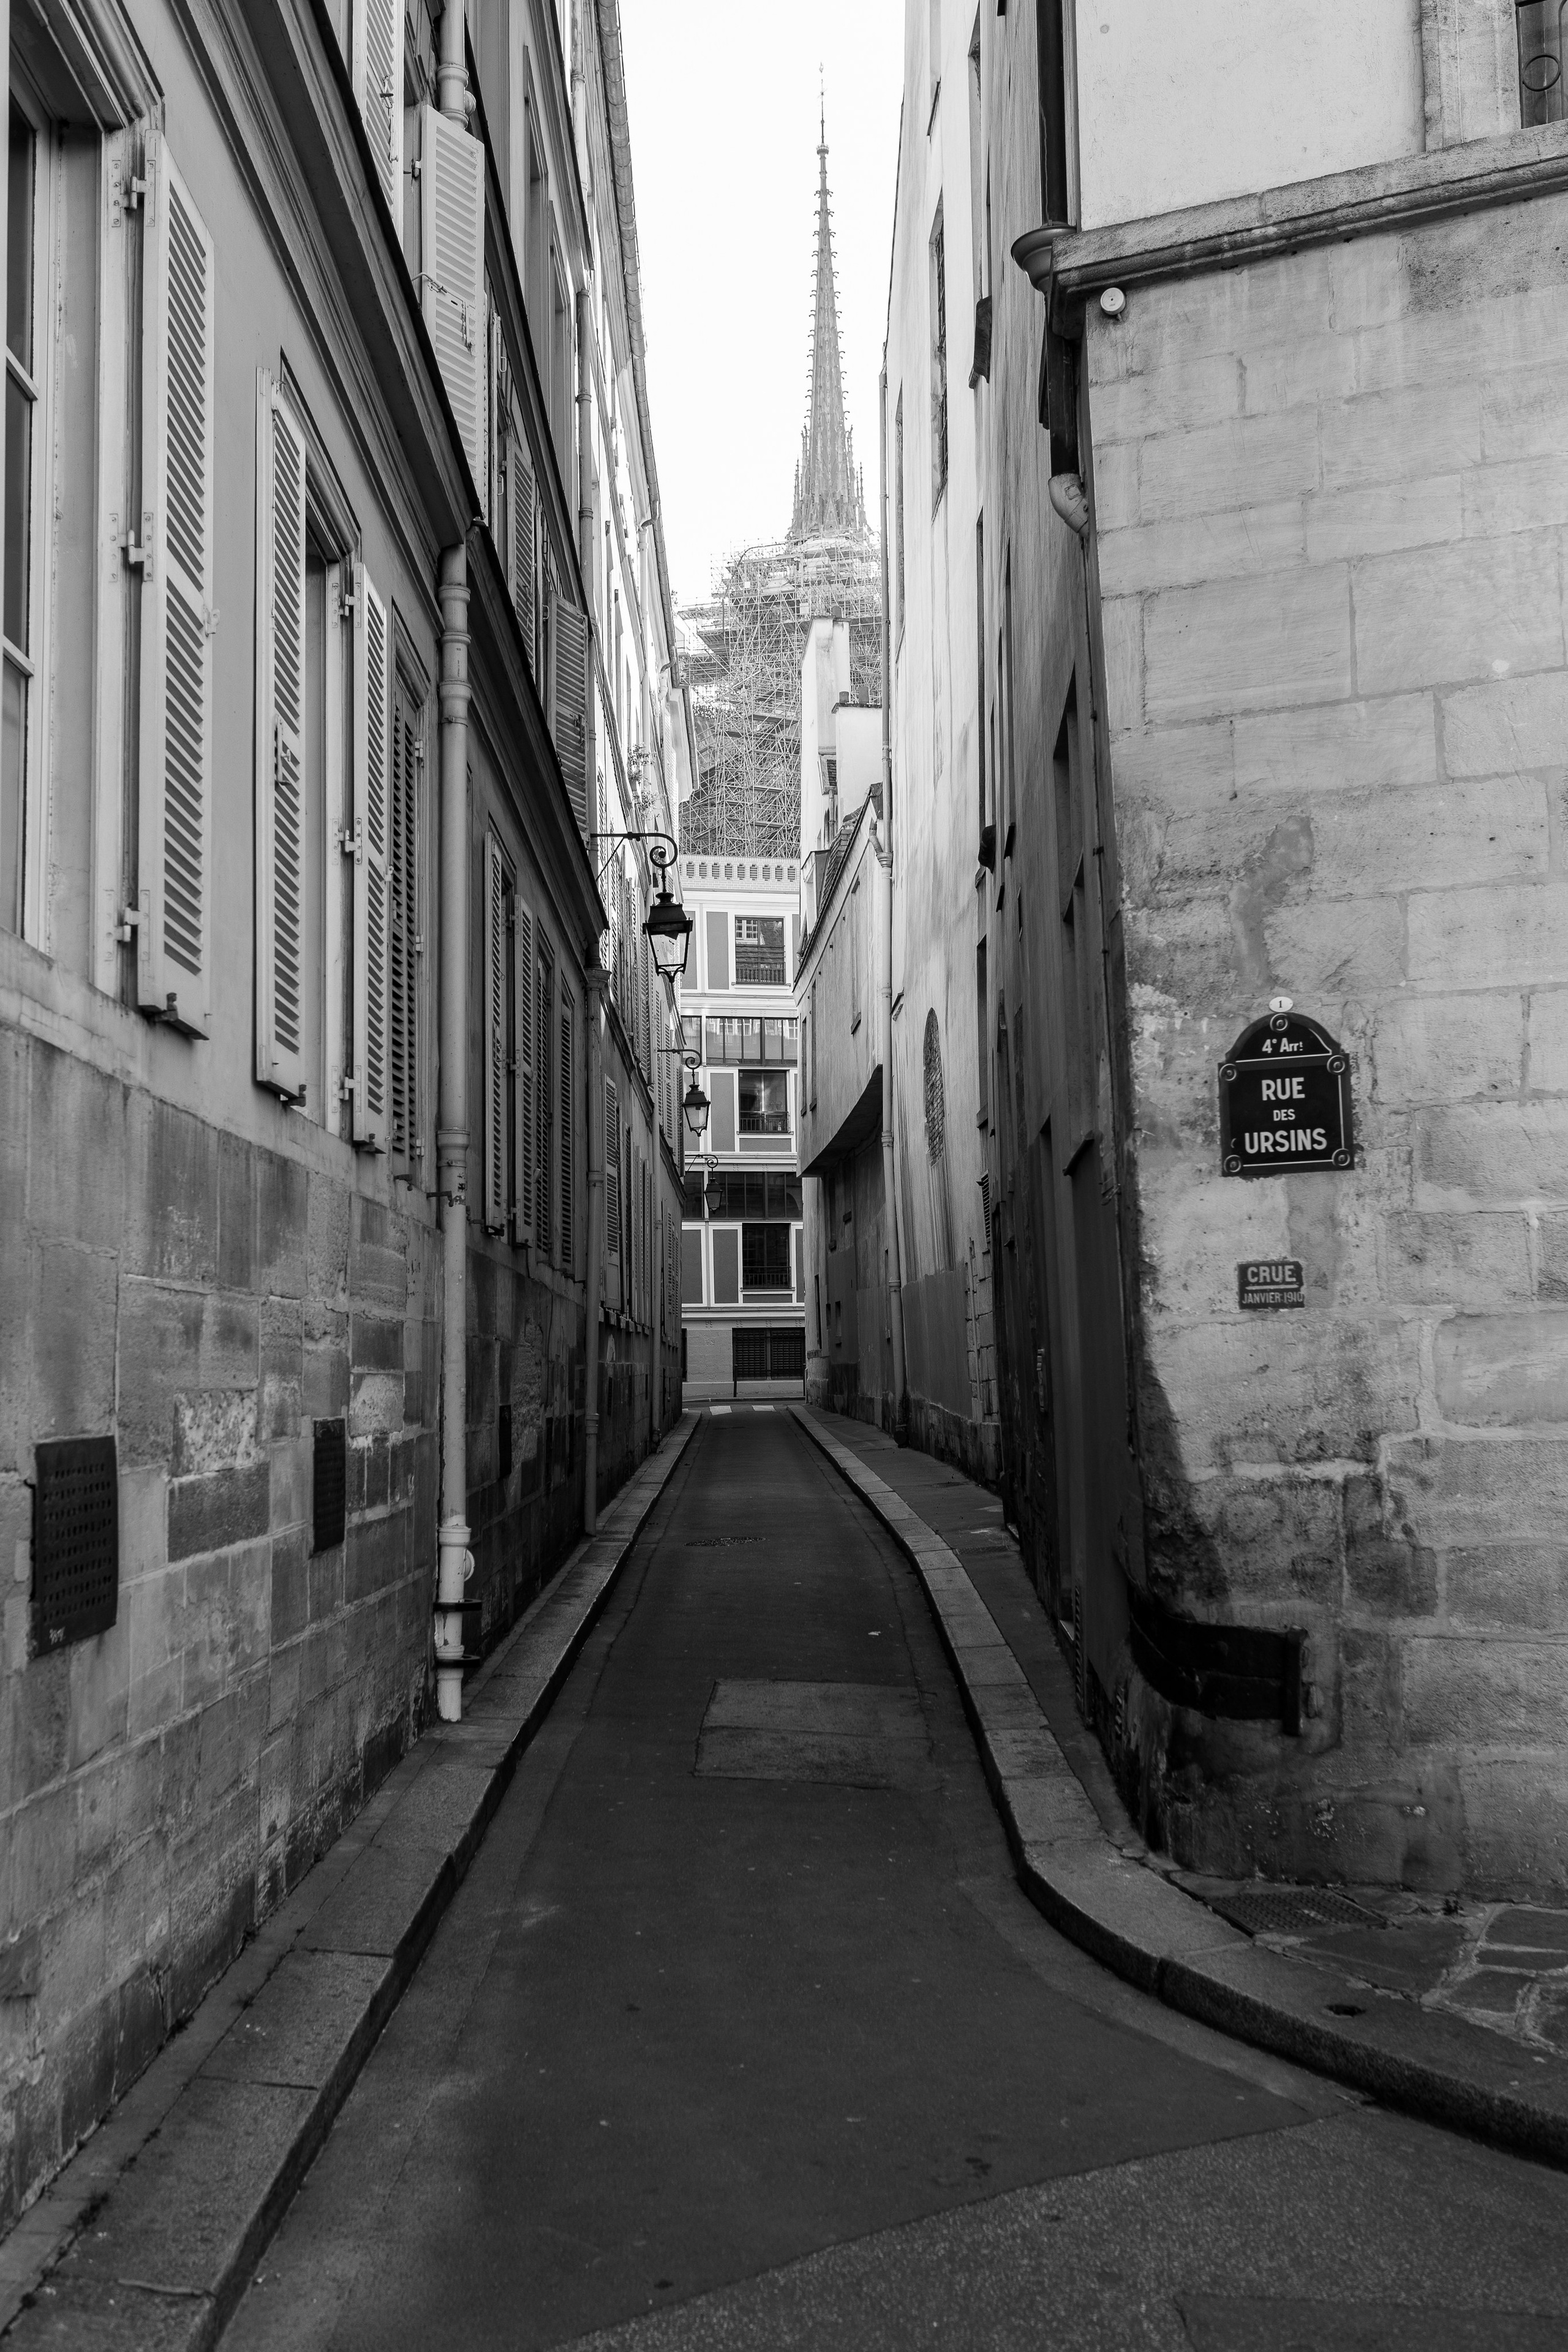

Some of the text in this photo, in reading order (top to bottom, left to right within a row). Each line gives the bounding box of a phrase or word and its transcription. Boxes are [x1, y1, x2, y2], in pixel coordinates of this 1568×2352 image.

[1262, 1077, 1305, 1101] RUE
[1273, 1109, 1295, 1121] DES
[1245, 1128, 1327, 1154] URSINS
[1247, 1265, 1297, 1283] CRUE
[1242, 1291, 1304, 1304] JANVIER 1910
